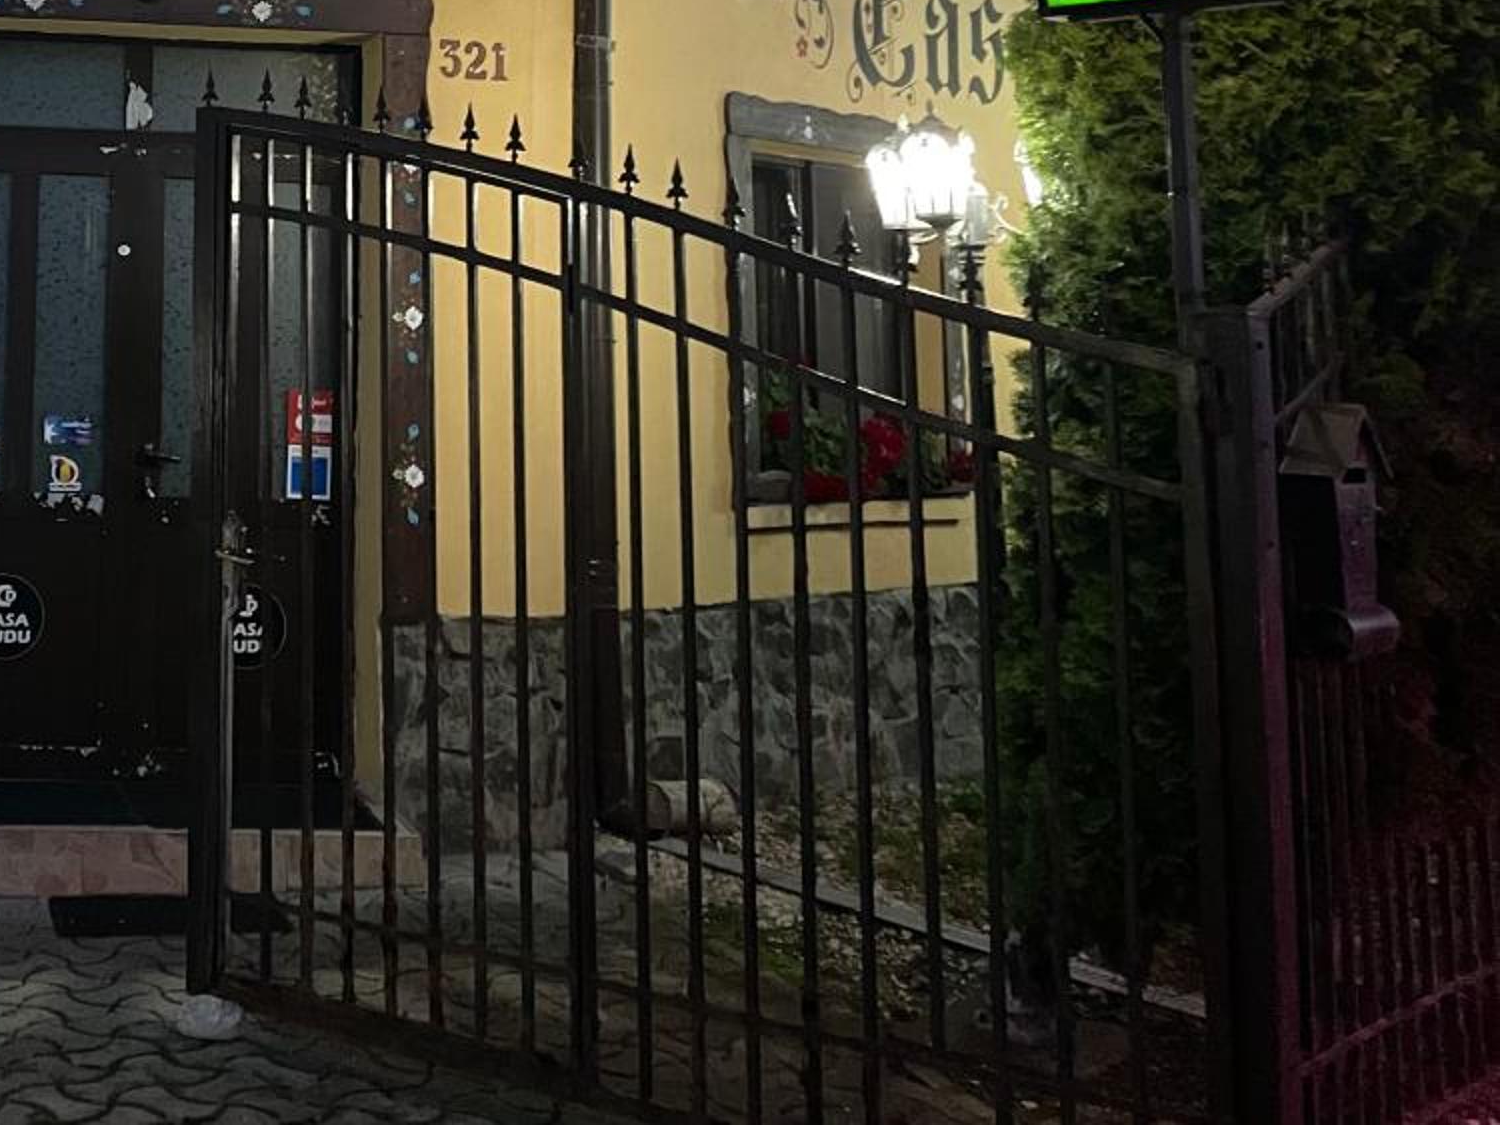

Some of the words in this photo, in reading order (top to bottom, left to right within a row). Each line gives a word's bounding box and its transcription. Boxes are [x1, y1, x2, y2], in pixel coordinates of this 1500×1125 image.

[439, 38, 509, 82] 321
[233, 622, 264, 636] AS
[233, 639, 261, 654] UD
